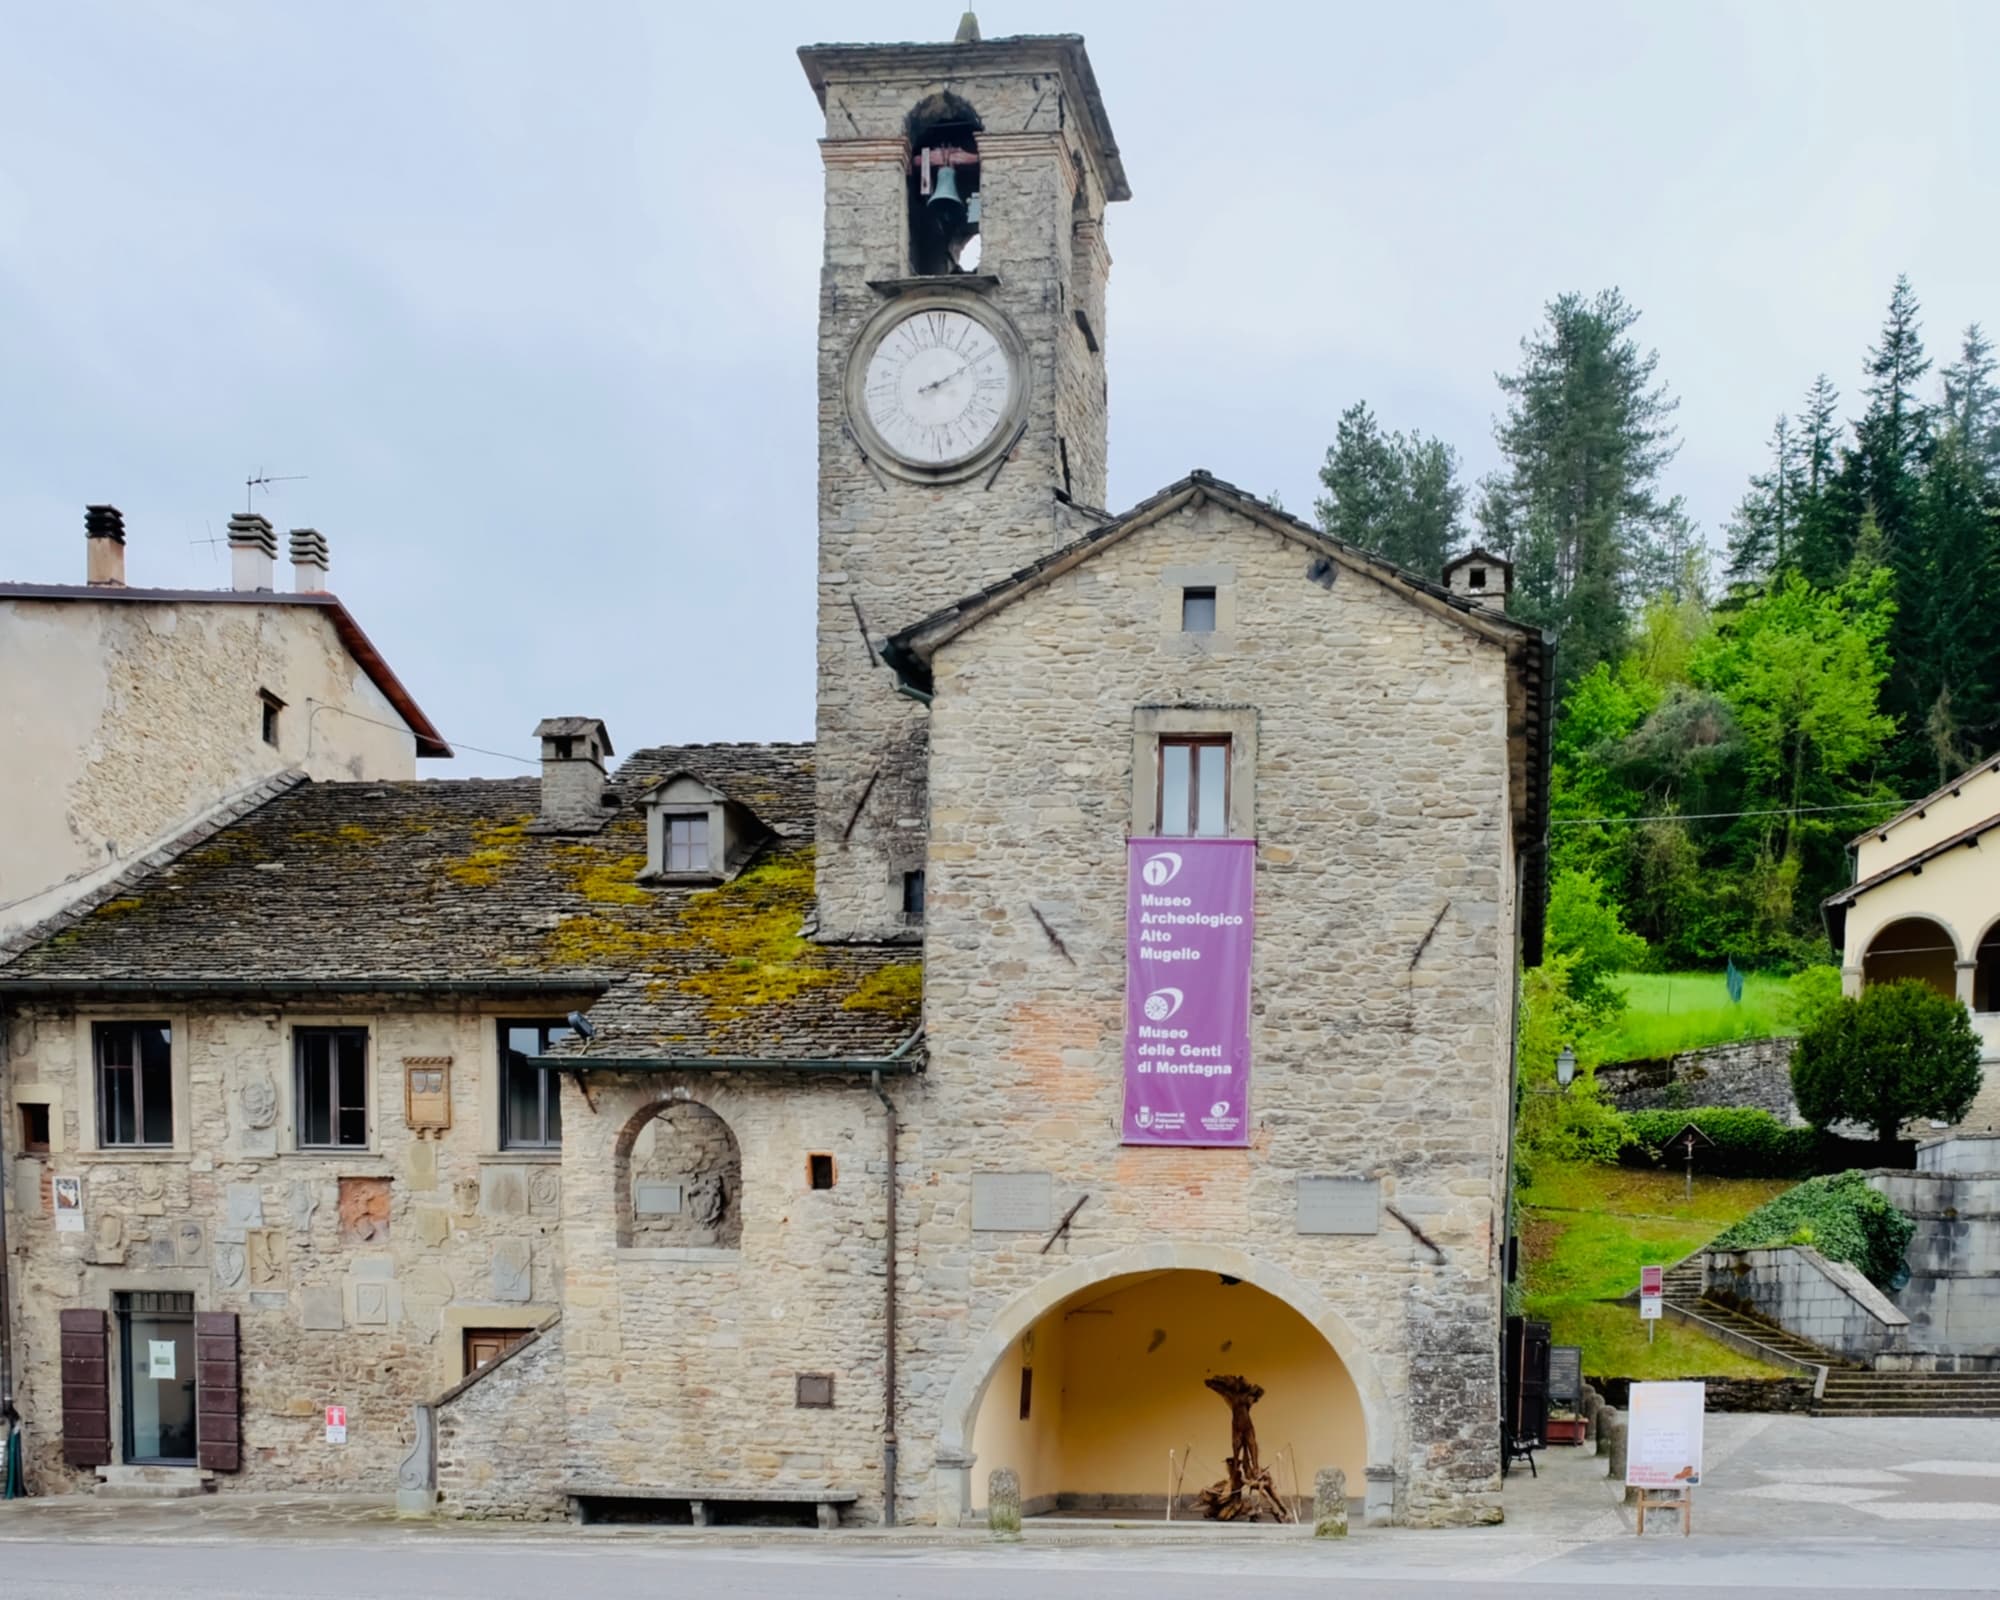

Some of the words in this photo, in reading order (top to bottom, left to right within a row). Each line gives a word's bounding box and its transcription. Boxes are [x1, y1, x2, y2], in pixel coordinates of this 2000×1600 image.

[1140, 893, 1192, 906] Museo
[1140, 912, 1243, 928] Archeologico
[1140, 929, 1172, 942] Alto
[1140, 946, 1200, 962] Mugello
[1138, 1025, 1189, 1039] Museo
[1138, 1043, 1176, 1056] delle
[1180, 1044, 1221, 1056] Genti
[1137, 1061, 1151, 1073] di
[1156, 1061, 1232, 1077] Montagna
